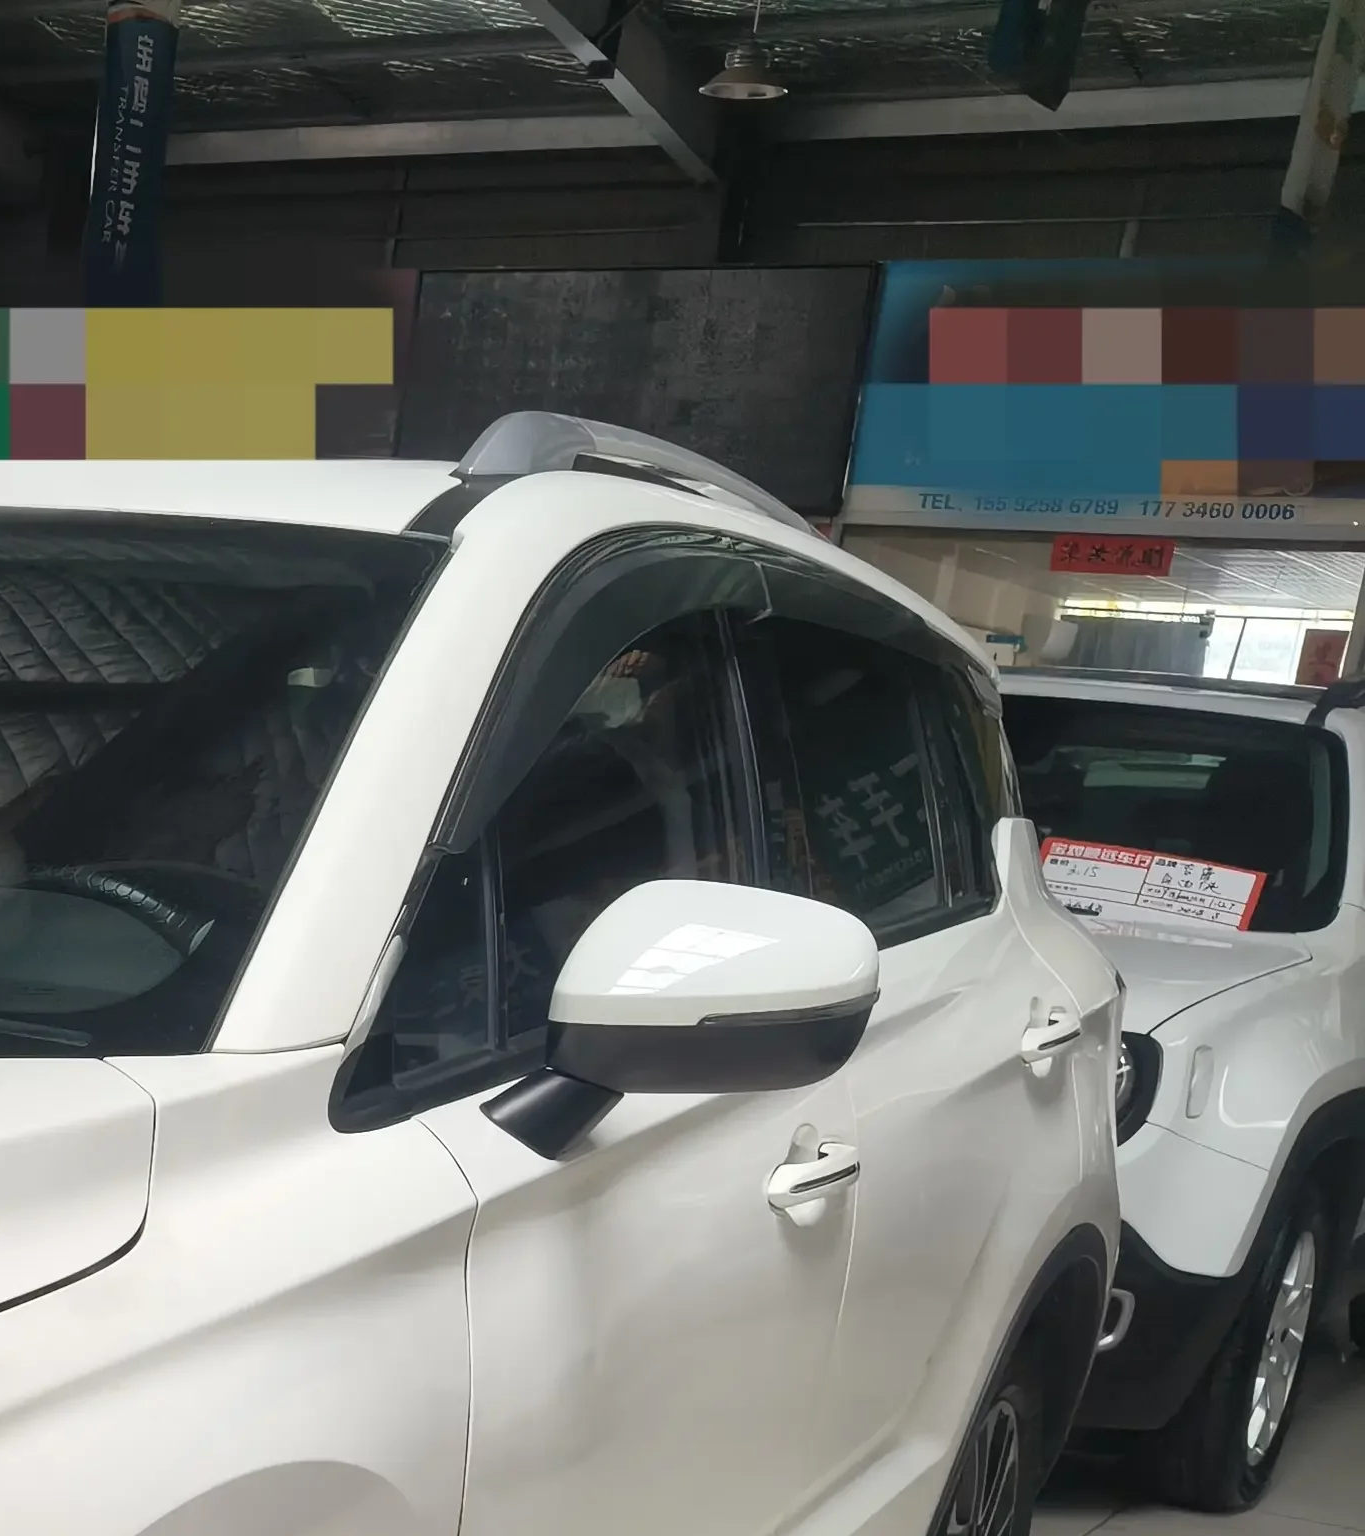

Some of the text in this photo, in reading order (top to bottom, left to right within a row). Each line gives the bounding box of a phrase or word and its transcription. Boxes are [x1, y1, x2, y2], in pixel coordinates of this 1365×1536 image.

[101, 199, 116, 244] CAR
[1069, 499, 1119, 515] 6789
[1140, 501, 1175, 518] 177
[1242, 503, 1295, 520] 0006
